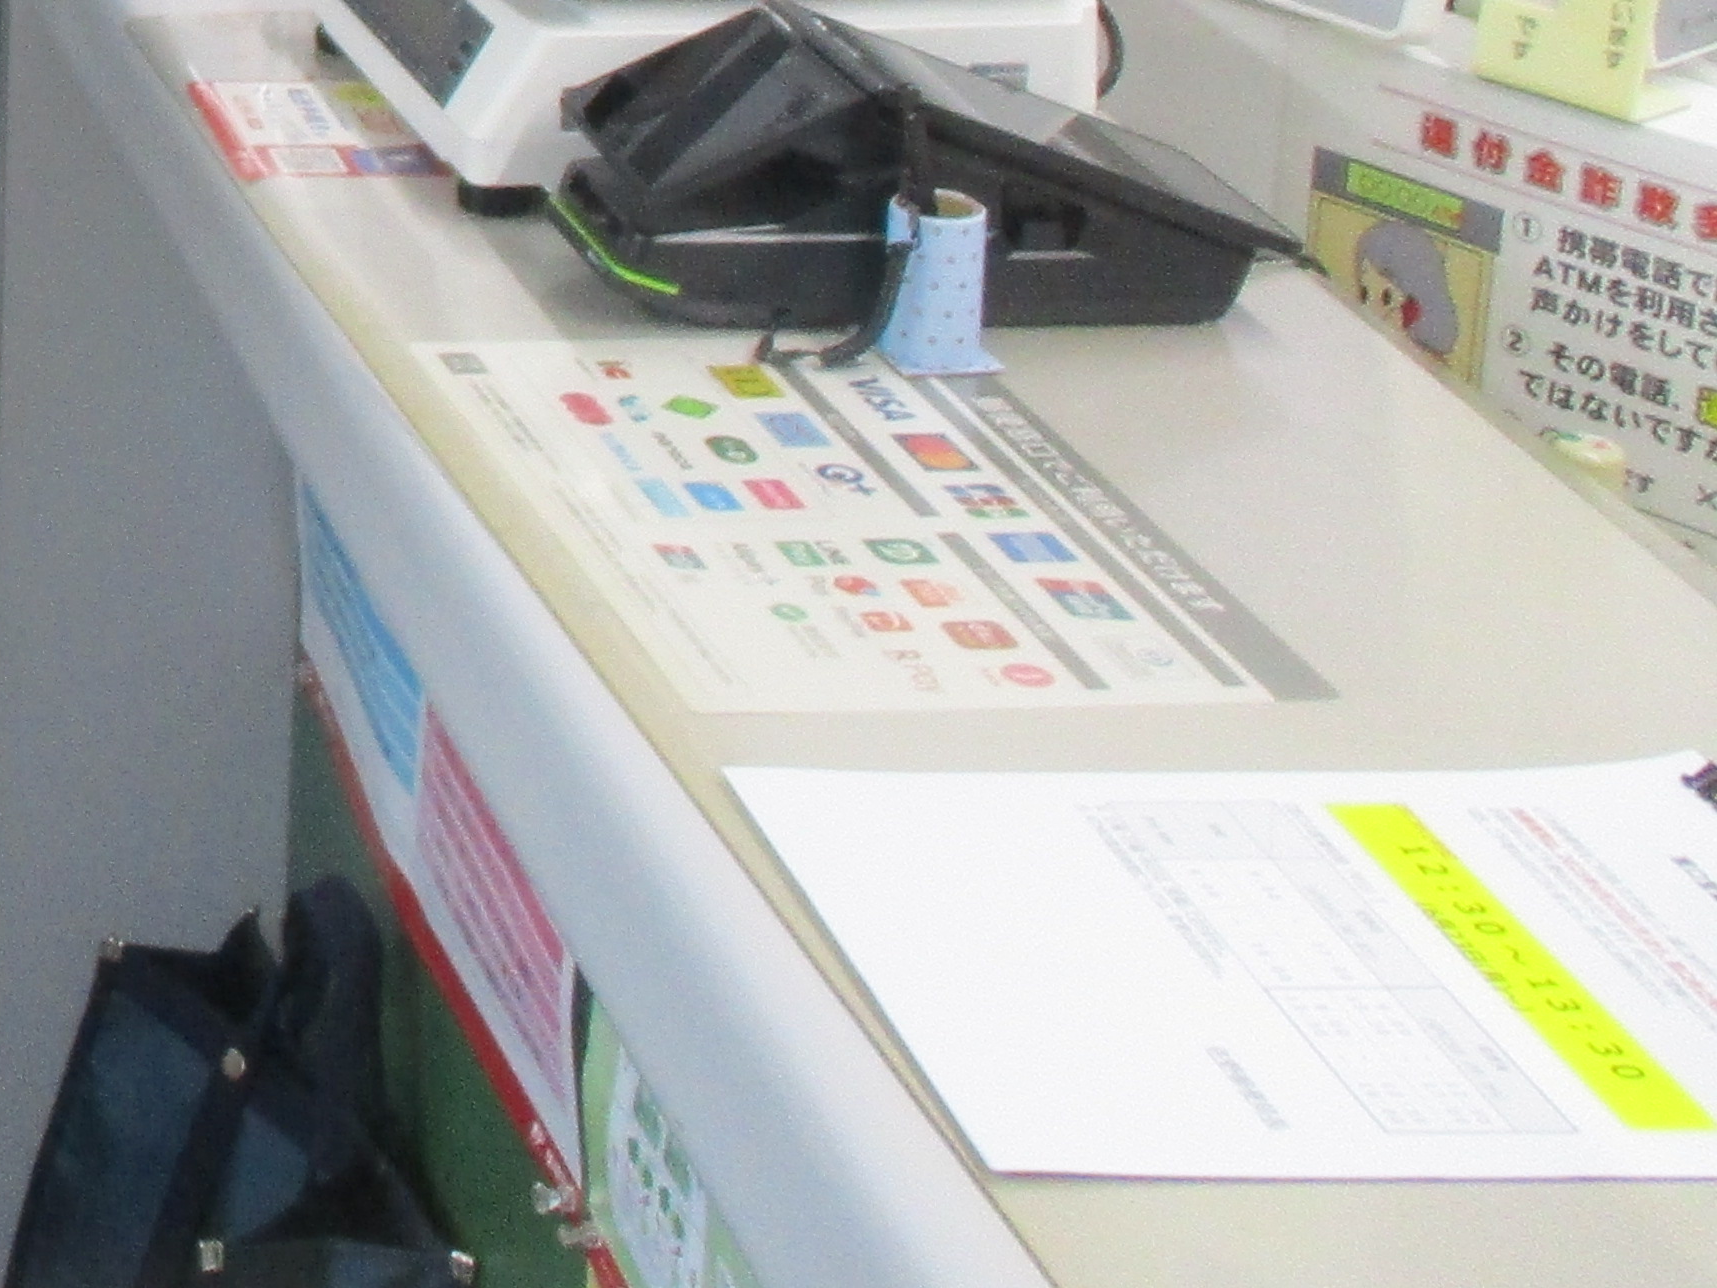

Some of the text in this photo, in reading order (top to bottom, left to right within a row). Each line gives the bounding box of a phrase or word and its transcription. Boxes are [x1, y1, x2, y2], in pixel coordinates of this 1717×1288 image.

[1558, 225, 1717, 297] 携帯電話で
[1530, 287, 1717, 371] 声かけをして
[849, 377, 916, 422] VISA
[1550, 342, 1681, 412] その電話、
